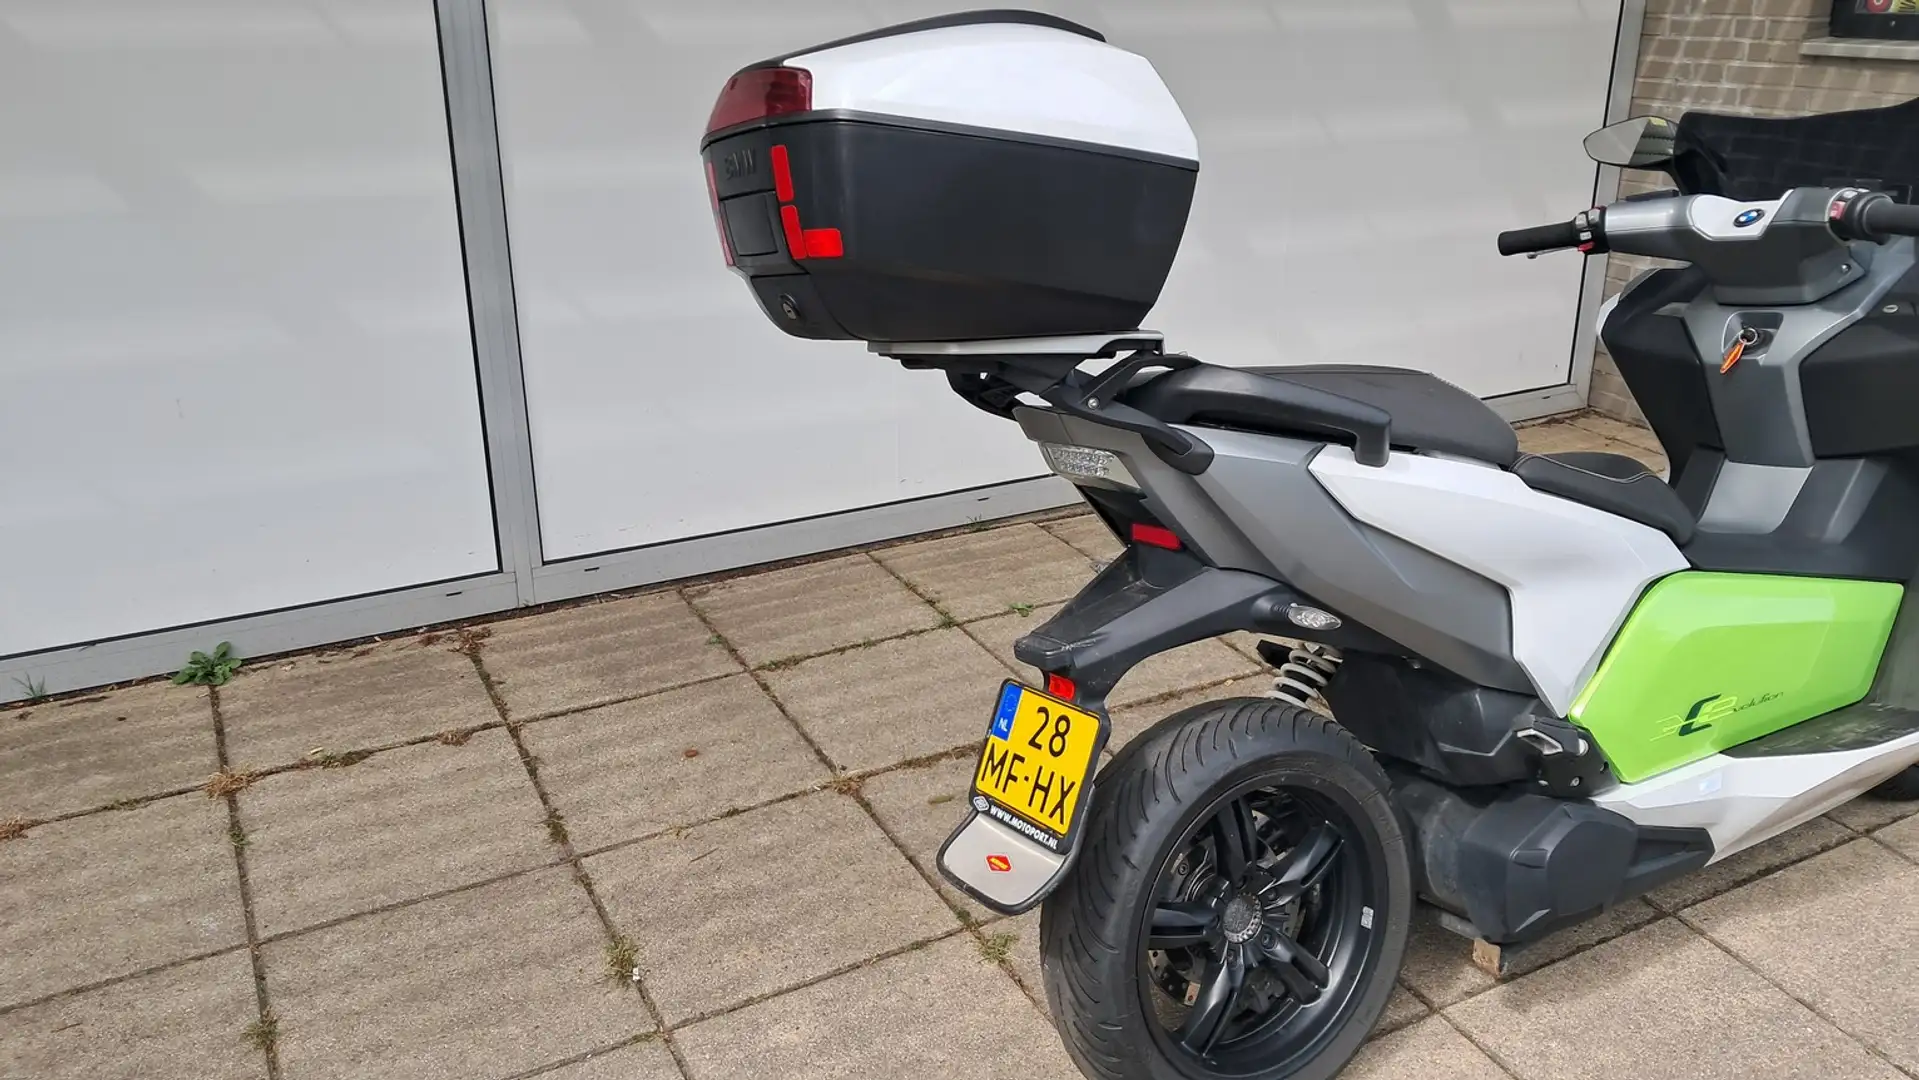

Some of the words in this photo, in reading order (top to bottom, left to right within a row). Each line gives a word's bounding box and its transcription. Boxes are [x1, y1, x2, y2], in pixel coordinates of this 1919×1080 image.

[997, 718, 1008, 732] NL
[1028, 706, 1071, 758] 28
[989, 804, 1059, 850] WWW.MOTOPORT.NL
